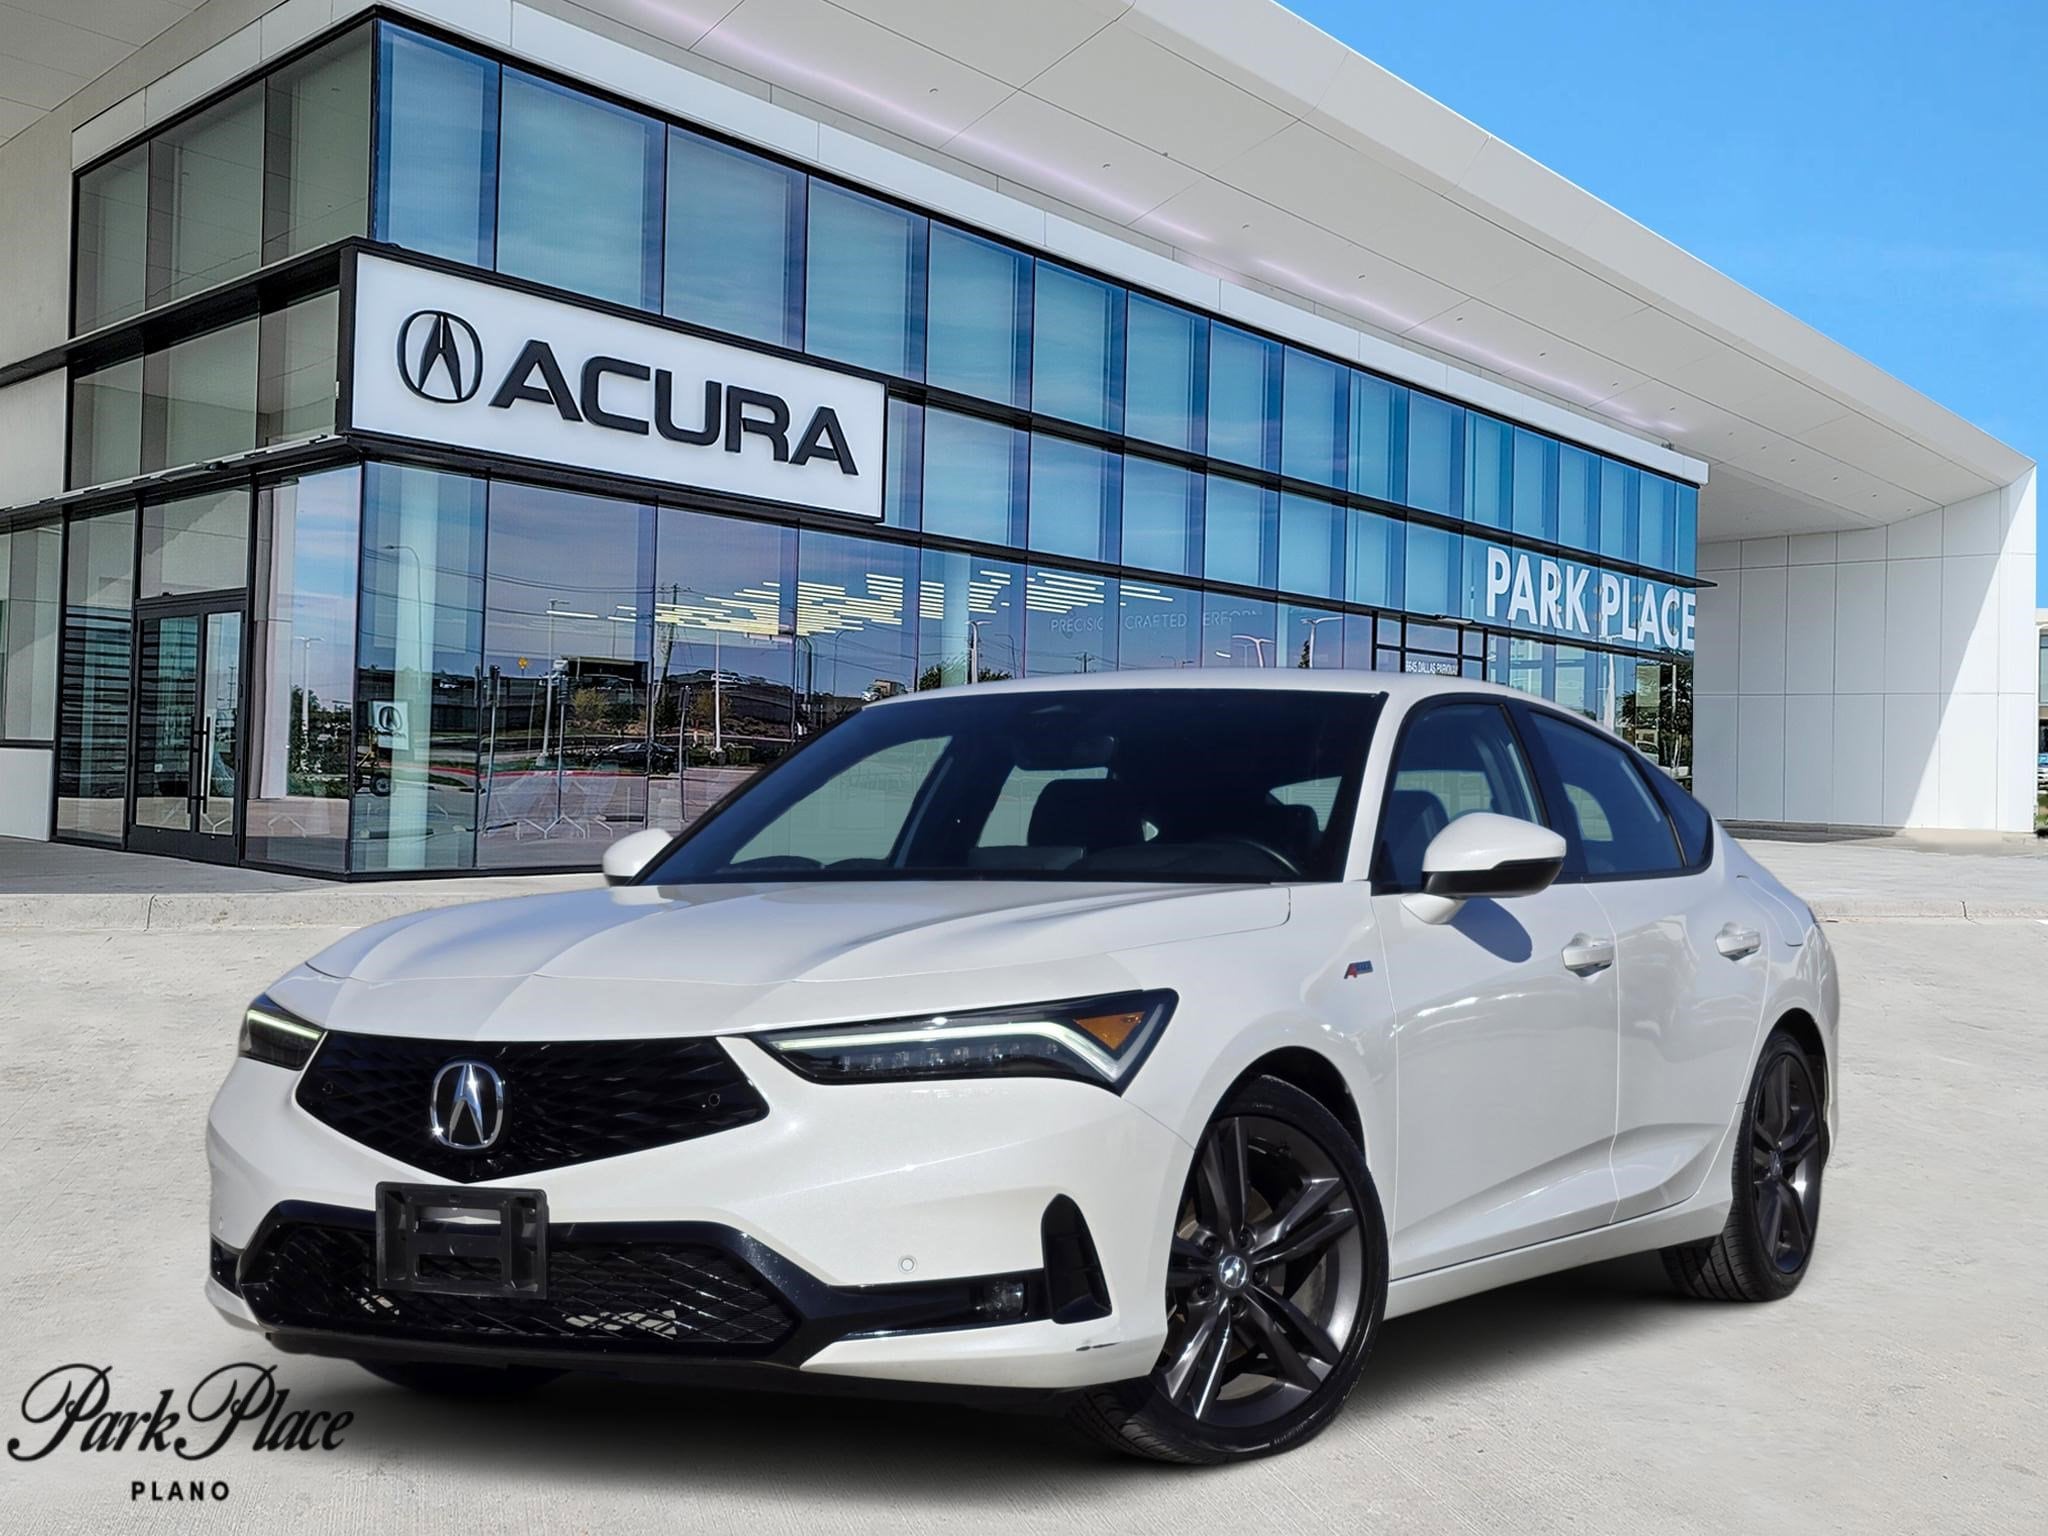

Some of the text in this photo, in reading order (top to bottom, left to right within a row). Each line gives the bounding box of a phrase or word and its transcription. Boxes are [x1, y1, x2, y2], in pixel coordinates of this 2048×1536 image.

[488, 340, 859, 476] ACURA
[1125, 613, 1187, 630] CRAFTED
[1486, 546, 1696, 650] PARK PLACE
